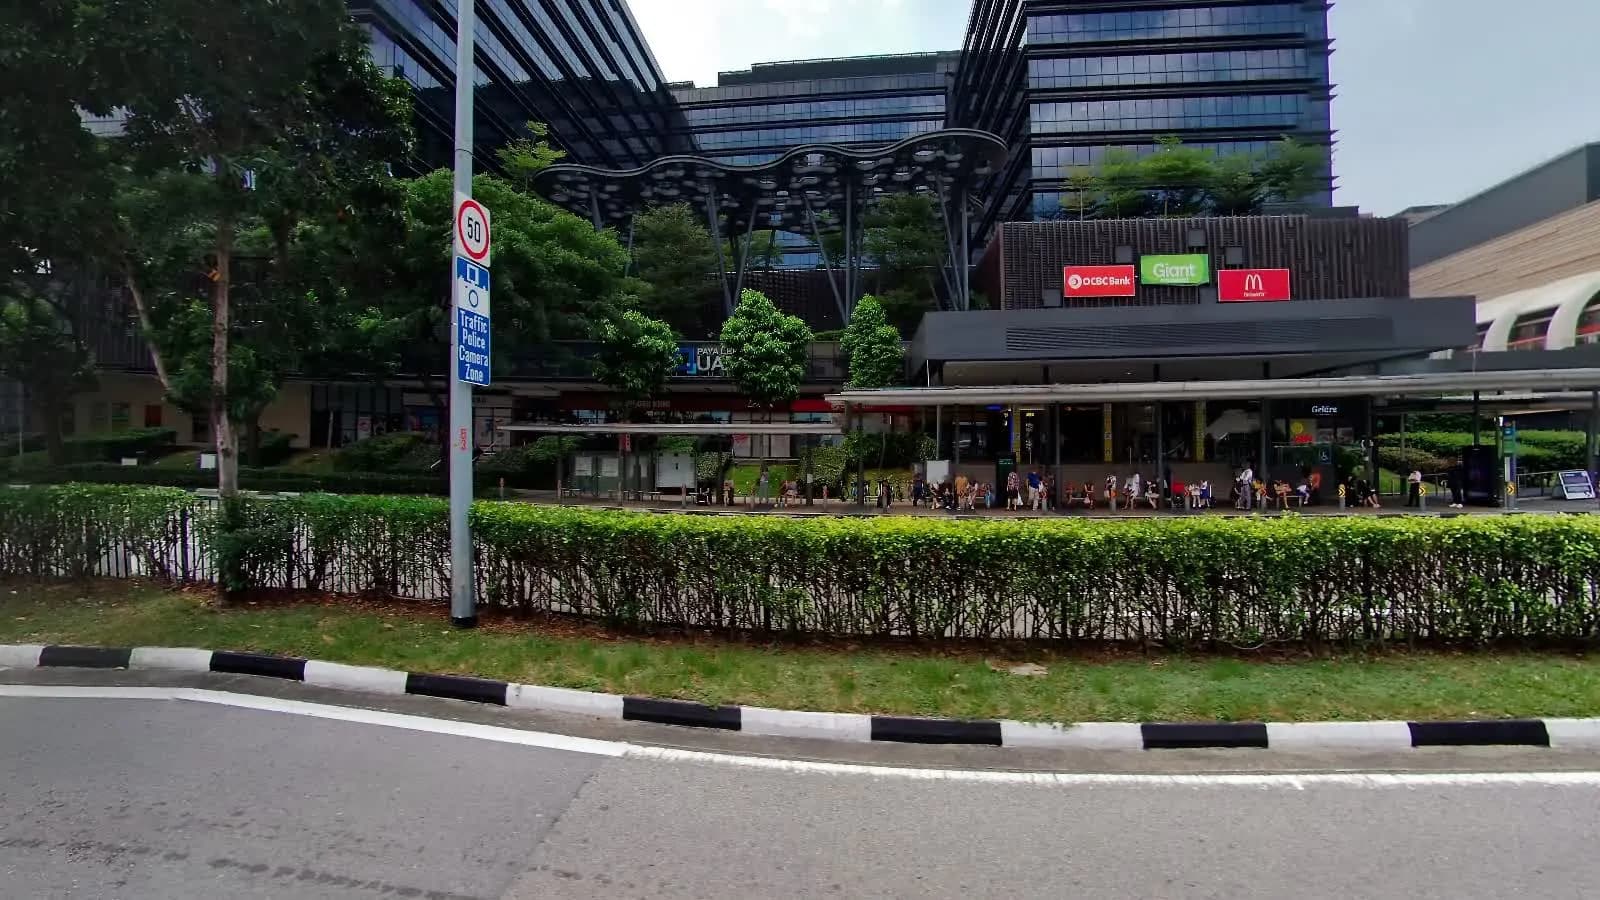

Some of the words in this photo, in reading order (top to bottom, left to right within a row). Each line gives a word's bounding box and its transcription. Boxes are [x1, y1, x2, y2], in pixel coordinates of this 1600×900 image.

[467, 216, 481, 243] 50
[1152, 262, 1196, 278] Giant
[1083, 276, 1108, 286] OCBC
[1109, 275, 1131, 286] Bank
[459, 310, 487, 333] Traffic
[462, 328, 486, 349] Police
[459, 345, 488, 367] Camera
[697, 347, 719, 355] PAYA
[465, 363, 484, 382] Zone
